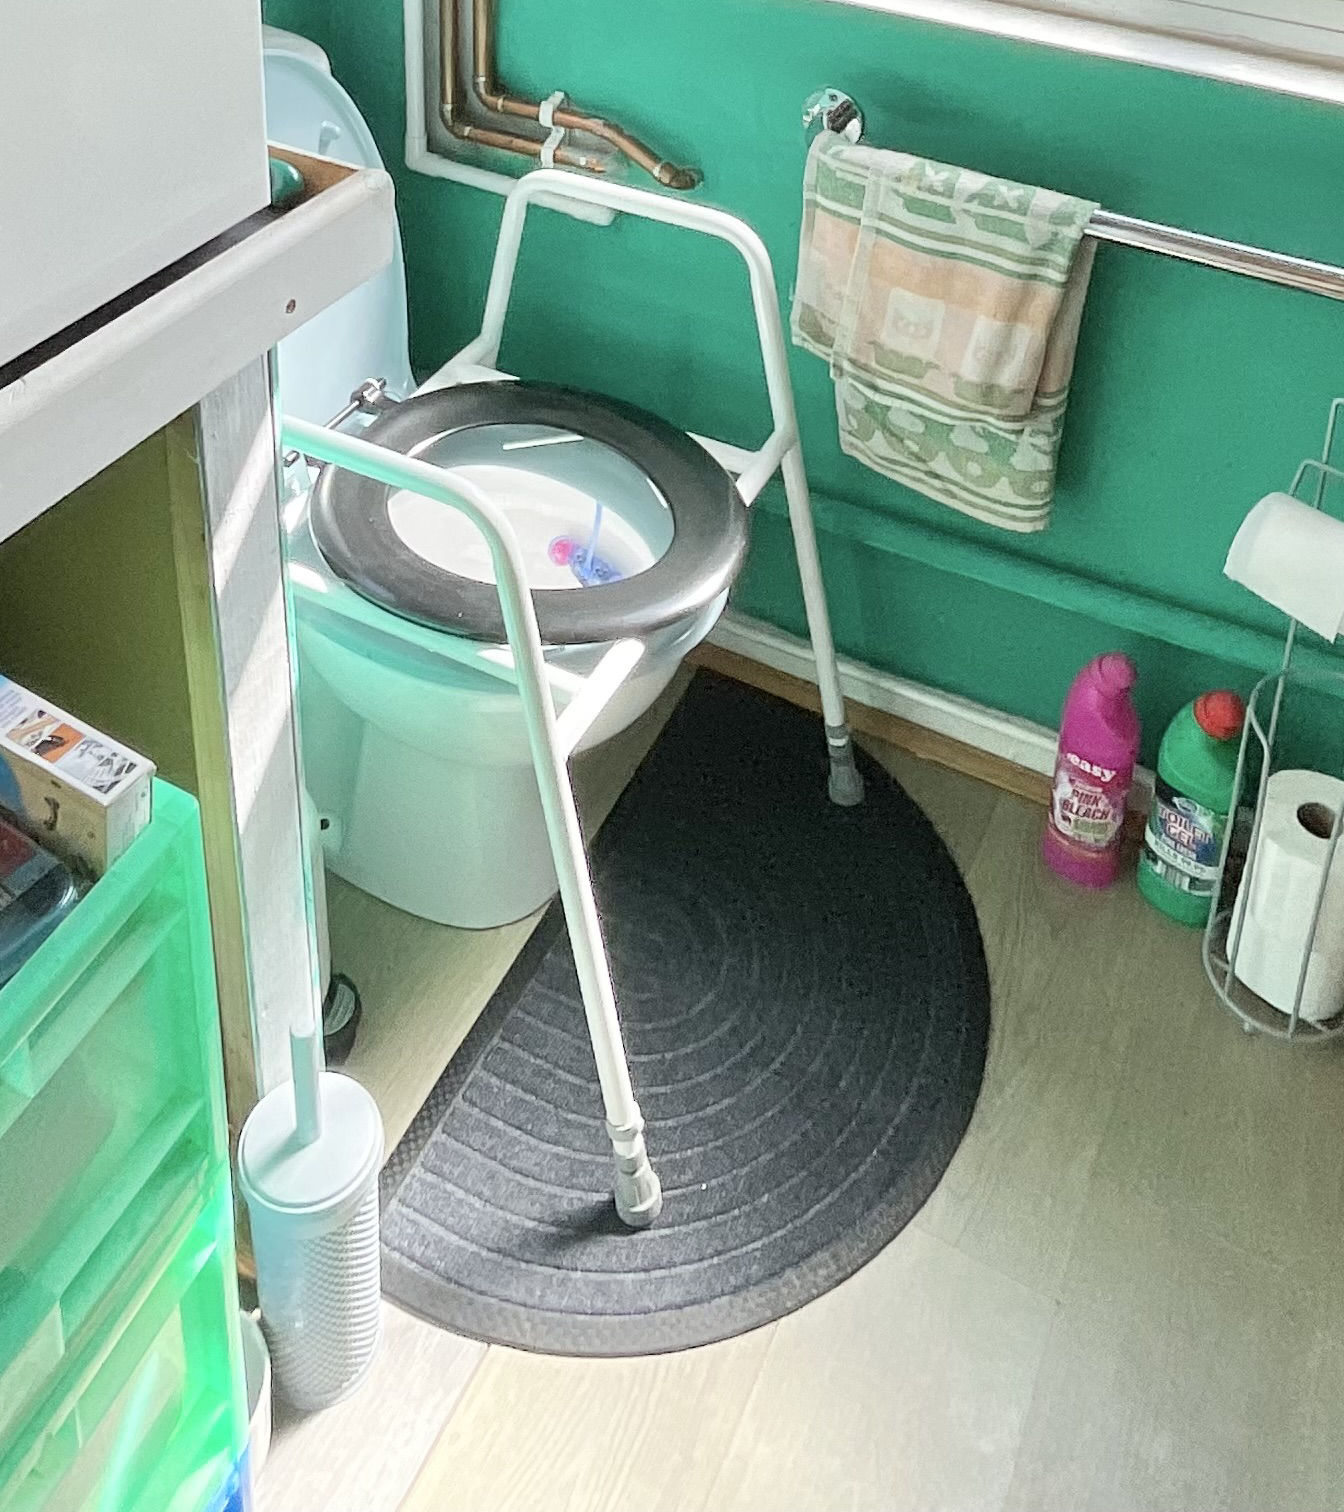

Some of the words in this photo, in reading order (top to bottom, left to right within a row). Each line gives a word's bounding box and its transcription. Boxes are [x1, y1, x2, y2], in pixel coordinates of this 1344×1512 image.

[1066, 752, 1117, 782] easy
[1071, 789, 1102, 808] PINK
[1061, 799, 1111, 820] BLEACH
